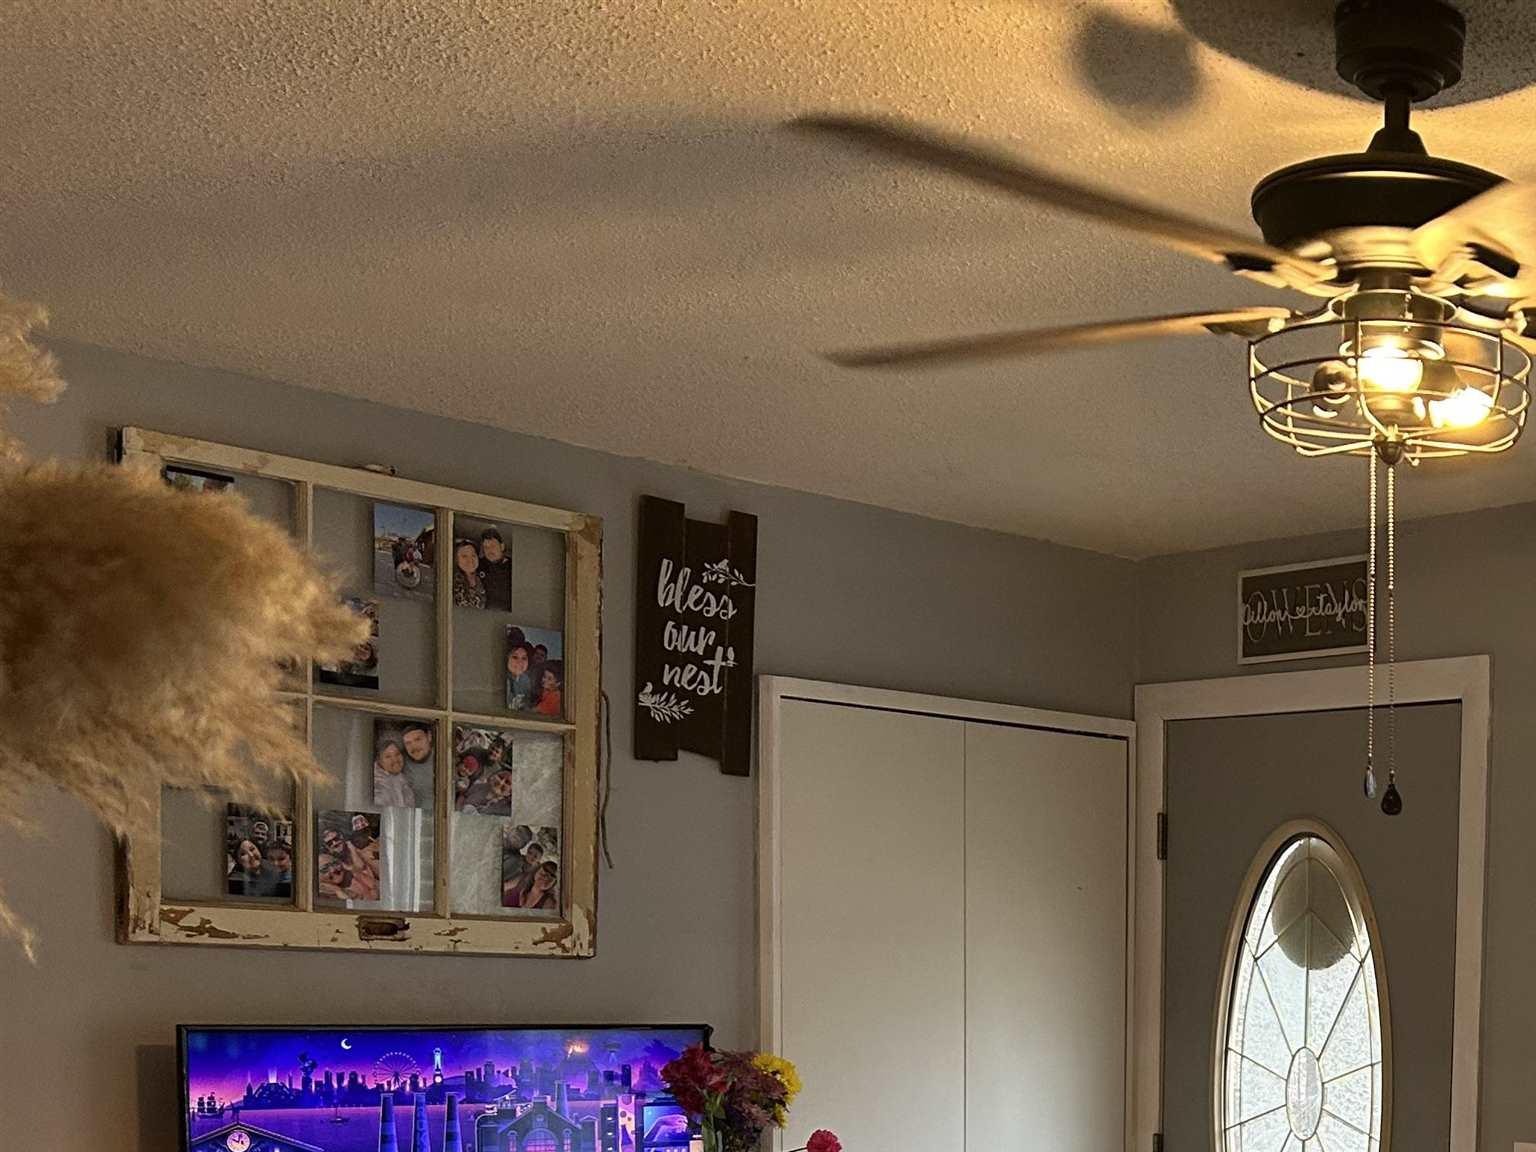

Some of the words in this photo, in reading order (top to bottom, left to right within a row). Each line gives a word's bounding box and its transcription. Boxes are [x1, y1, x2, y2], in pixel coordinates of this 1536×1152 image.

[657, 558, 737, 620] bless
[663, 620, 716, 655] our
[662, 646, 737, 696] nest
